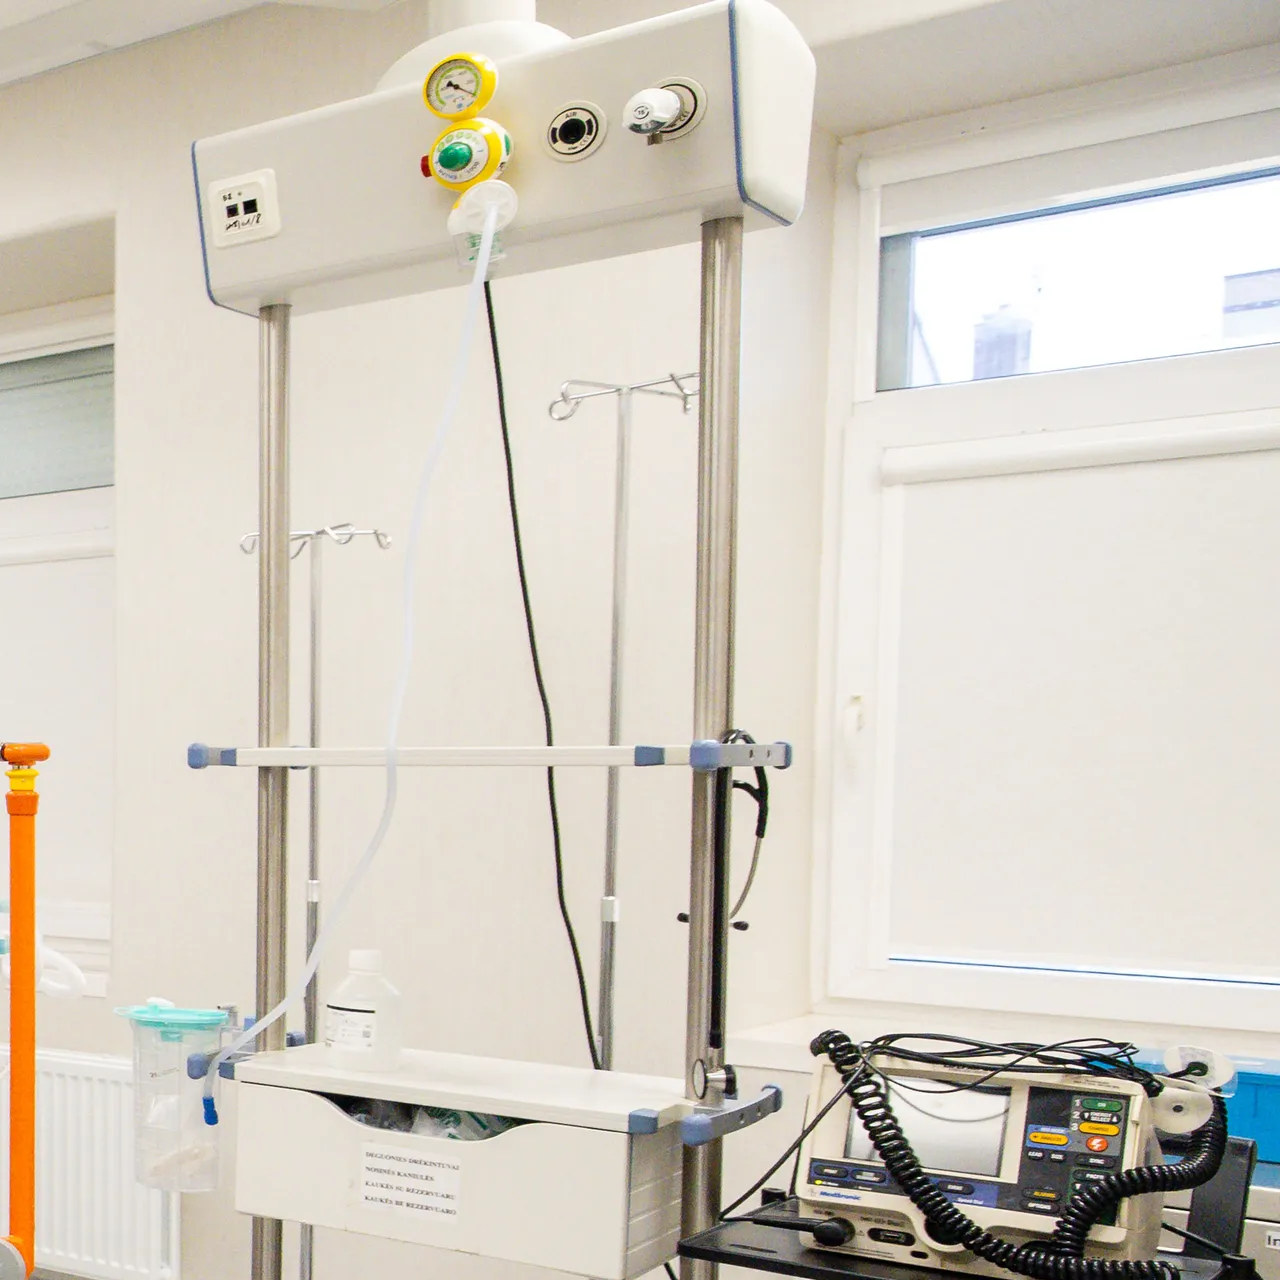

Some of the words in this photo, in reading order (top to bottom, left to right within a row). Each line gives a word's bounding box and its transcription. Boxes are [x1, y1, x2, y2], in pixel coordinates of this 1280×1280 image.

[365, 1152, 407, 1162] DEGUONIES
[409, 1158, 459, 1170] DRĖKINTUVAI
[365, 1181, 393, 1189] KAUKĖS
[365, 1195, 393, 1204] KAUKĖS
[819, 1191, 861, 1200] Medtronic
